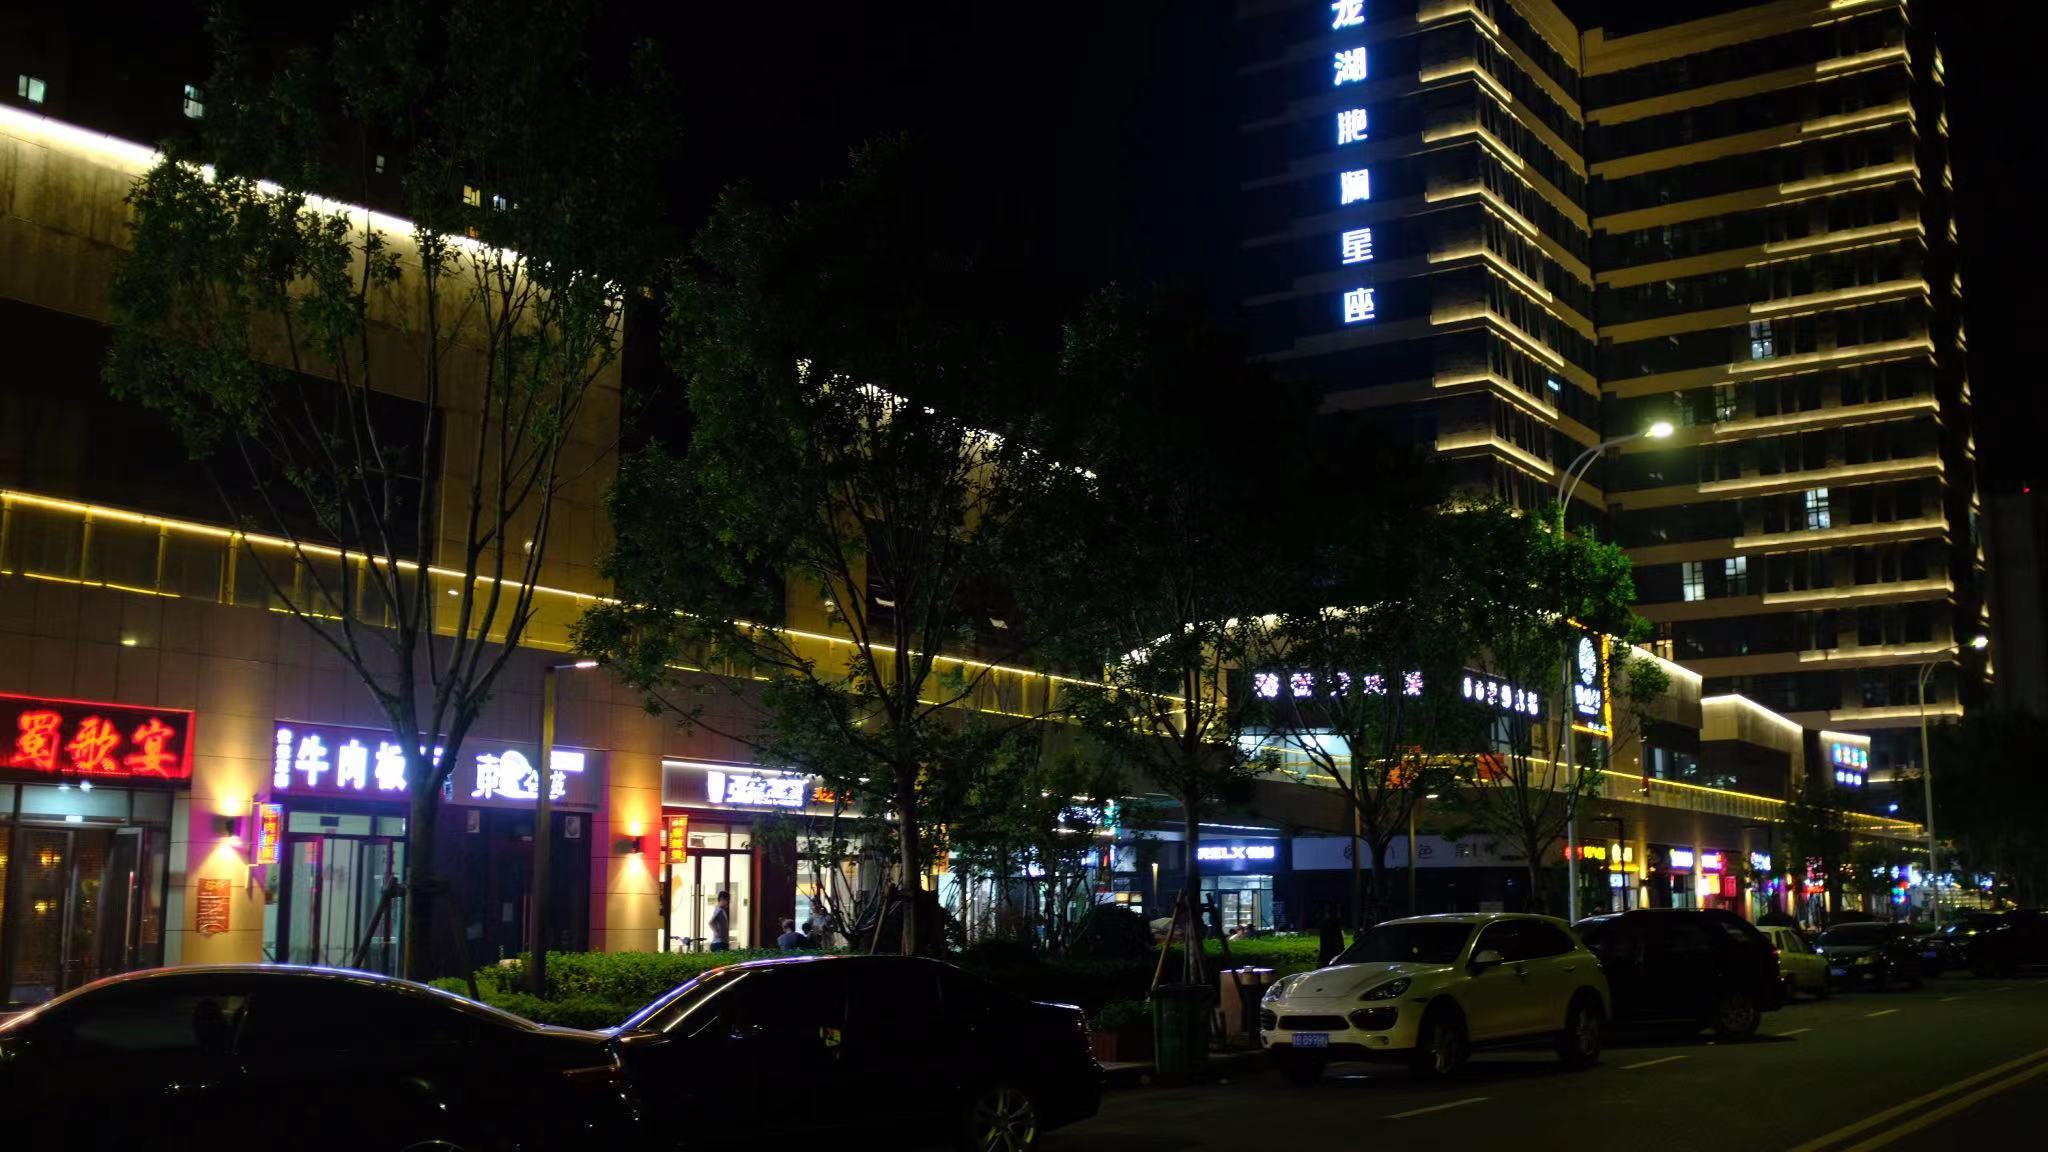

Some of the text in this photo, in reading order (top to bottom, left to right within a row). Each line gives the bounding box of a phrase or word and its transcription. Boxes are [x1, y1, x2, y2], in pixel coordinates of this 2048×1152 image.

[10, 710, 178, 780] 蜀歌宴
[295, 734, 444, 792] 牛肉板
